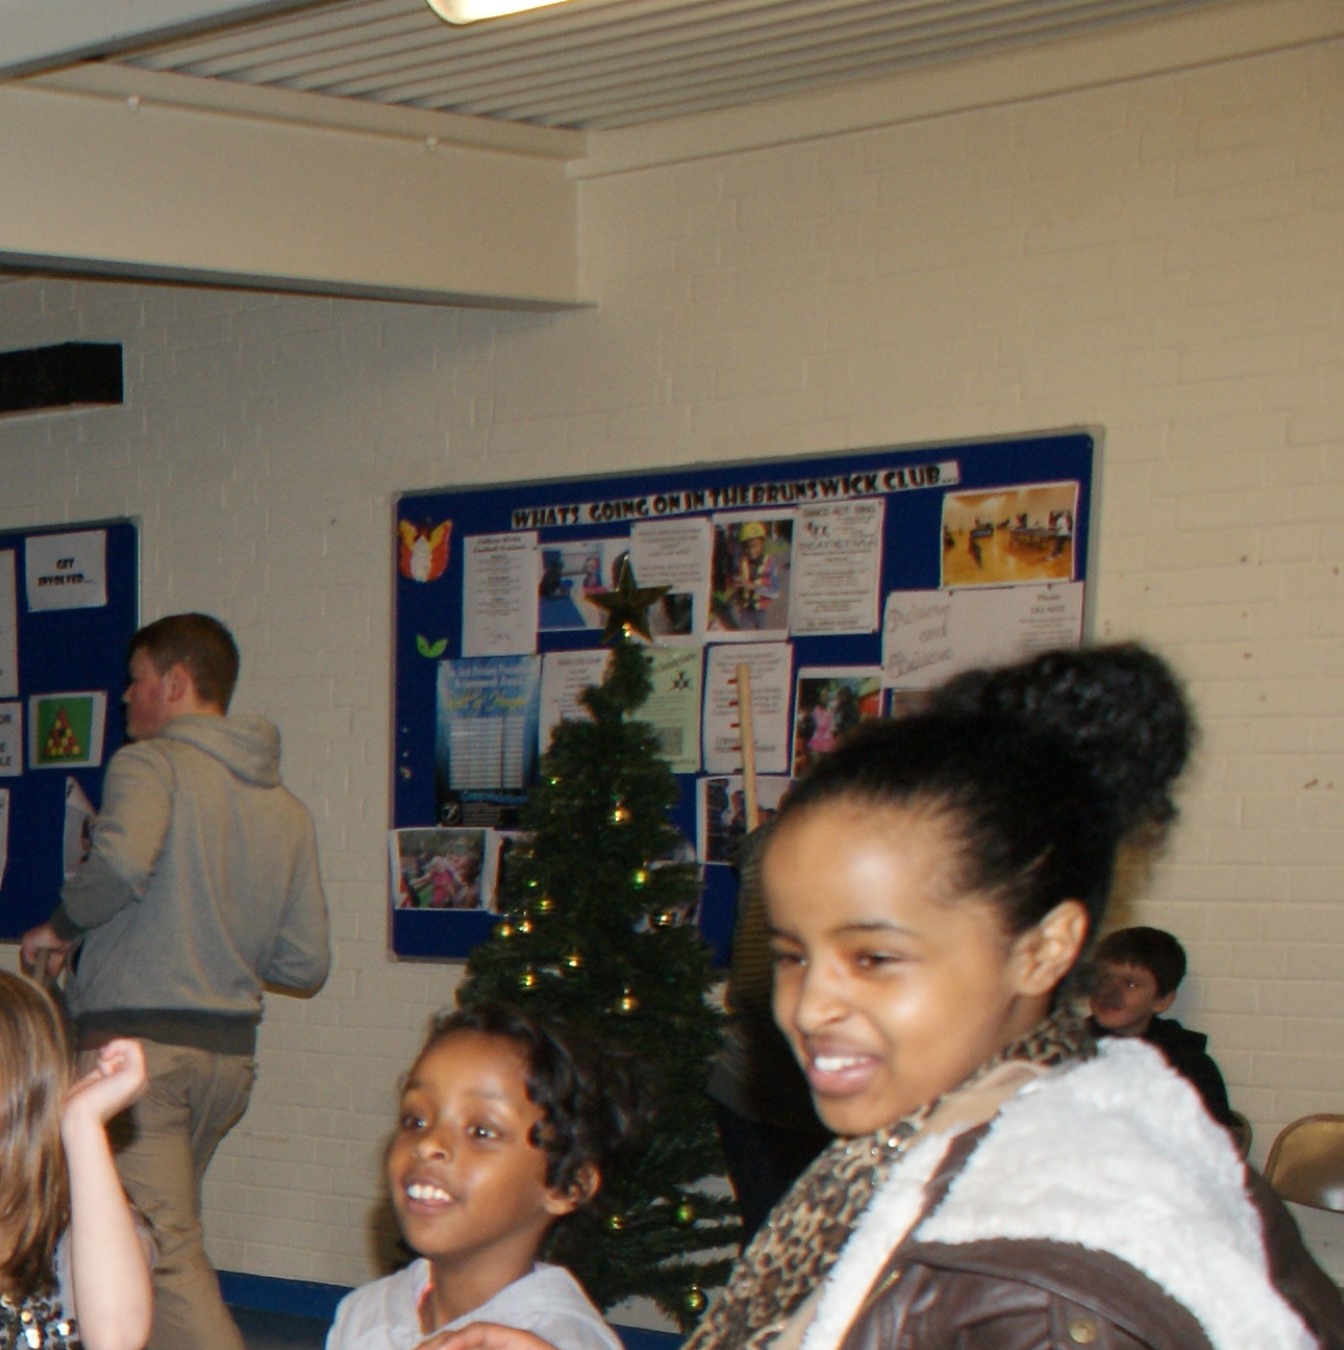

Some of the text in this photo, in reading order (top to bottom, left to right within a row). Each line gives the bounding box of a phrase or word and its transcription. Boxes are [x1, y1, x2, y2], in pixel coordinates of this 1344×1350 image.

[513, 505, 579, 527] WHATS
[589, 499, 649, 521] GOING
[653, 494, 680, 513] ON
[684, 492, 704, 508] IN
[750, 474, 877, 504] BRUNSWICK
